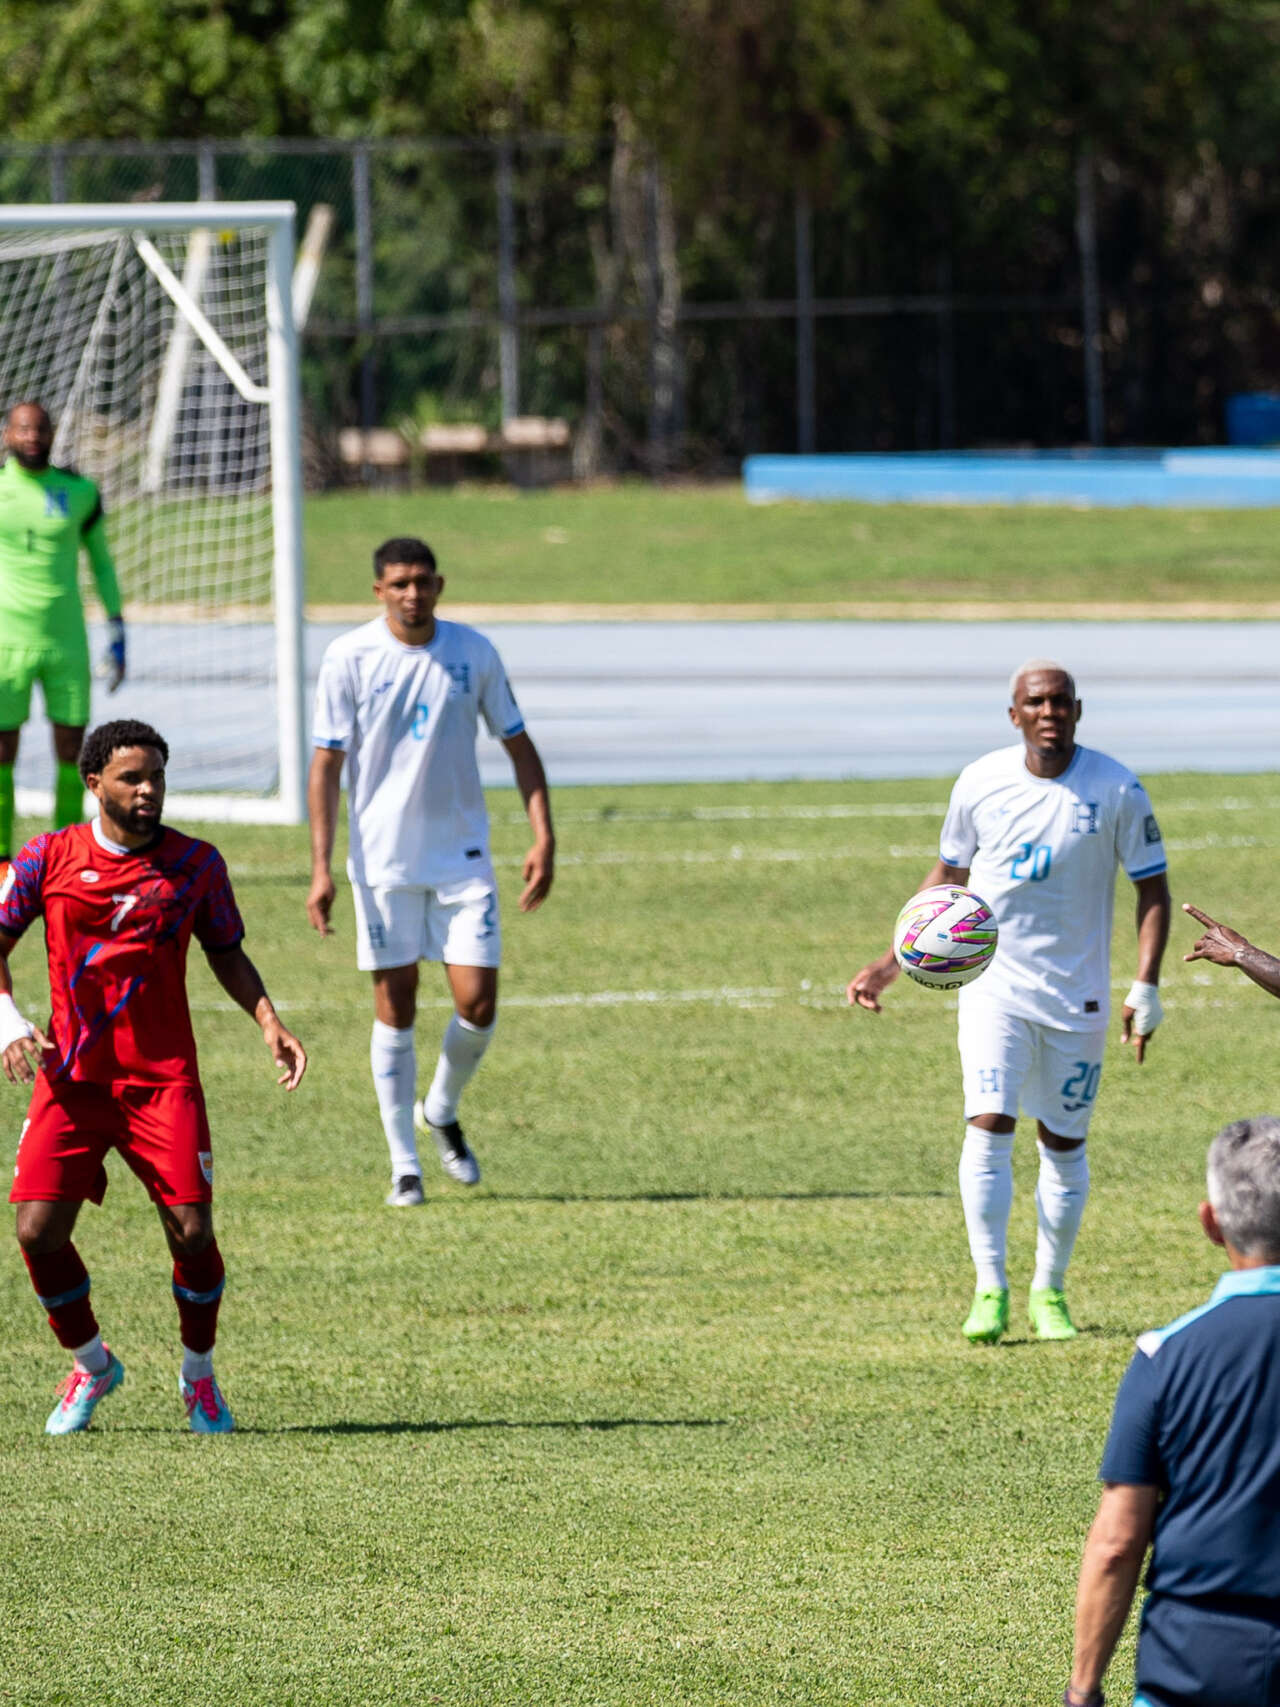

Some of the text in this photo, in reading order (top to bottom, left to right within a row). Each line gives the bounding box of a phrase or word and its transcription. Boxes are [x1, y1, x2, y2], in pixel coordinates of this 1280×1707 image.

[410, 703, 429, 741] 2
[1071, 802, 1098, 834] H
[1010, 842, 1052, 882] 20
[110, 893, 138, 932] 7
[977, 1067, 1000, 1094] H
[1061, 1061, 1101, 1102] 20
